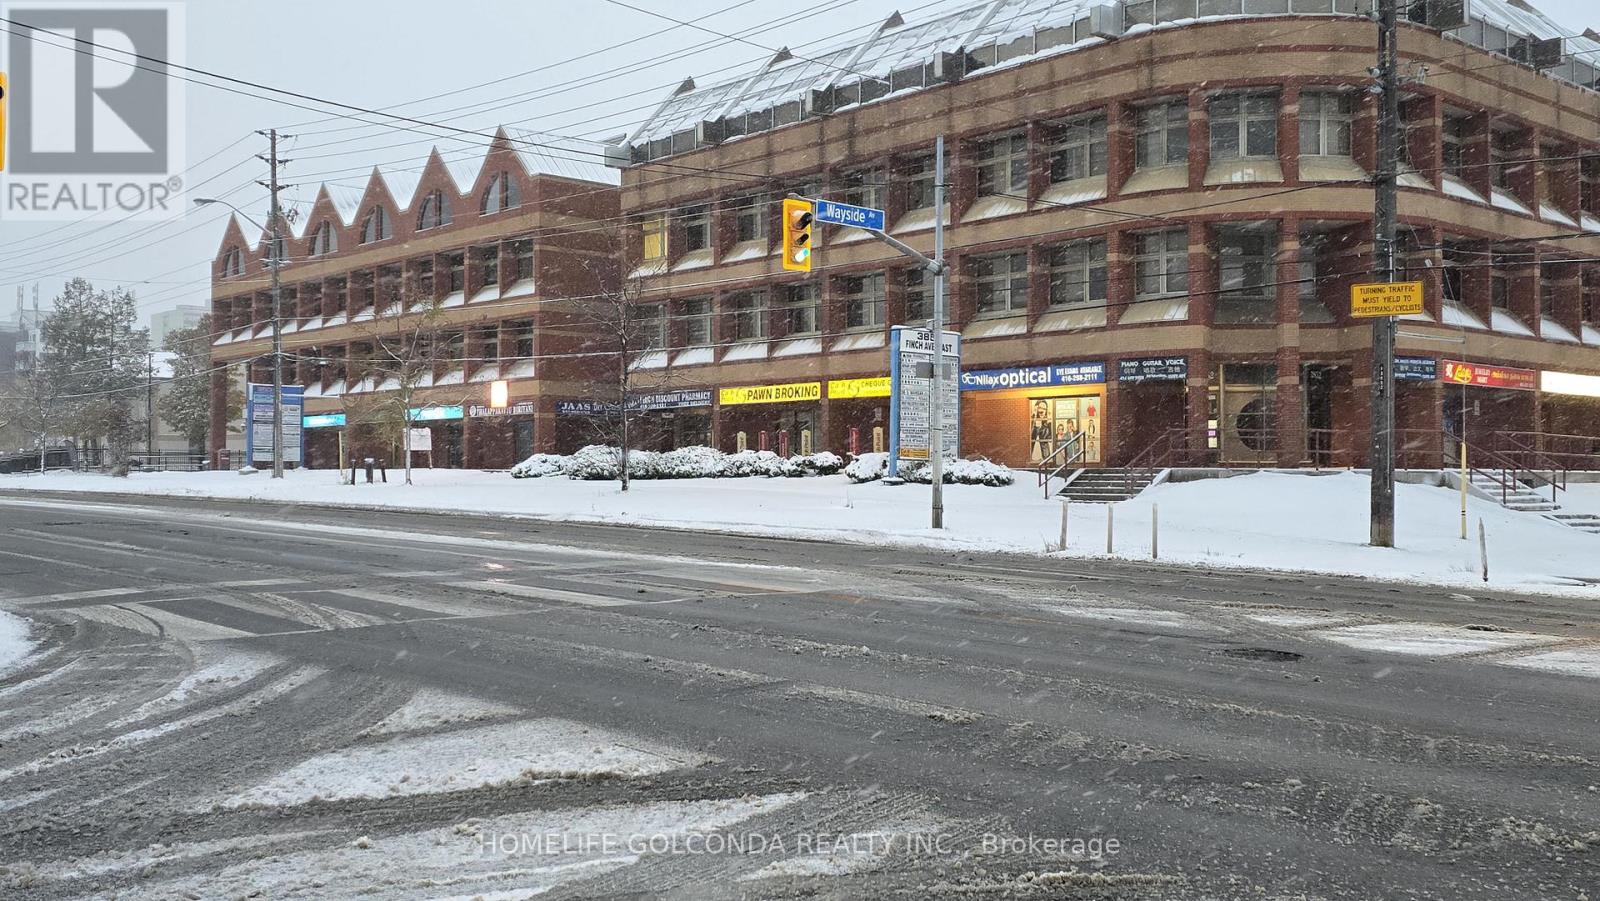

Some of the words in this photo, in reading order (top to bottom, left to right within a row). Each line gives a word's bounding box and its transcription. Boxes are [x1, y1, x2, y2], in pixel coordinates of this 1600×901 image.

[826, 203, 866, 223] Wayside
[1360, 287, 1386, 295] TURNING
[1389, 285, 1415, 293] TRAFFIC
[1362, 296, 1379, 304] MUST
[1383, 295, 1401, 303] YIELD
[1404, 294, 1412, 302] TO
[905, 339, 923, 350] FINCH
[924, 341, 935, 351] AVE
[1165, 358, 1186, 366] VOICE
[999, 366, 1051, 388] optical
[861, 379, 886, 388] CHEQUE
[655, 393, 681, 403] DISCOUNT
[681, 391, 711, 402] PHARMACY
[747, 389, 773, 401] PAWN
[775, 385, 818, 400] BROKING
[561, 402, 591, 411] JAAS
